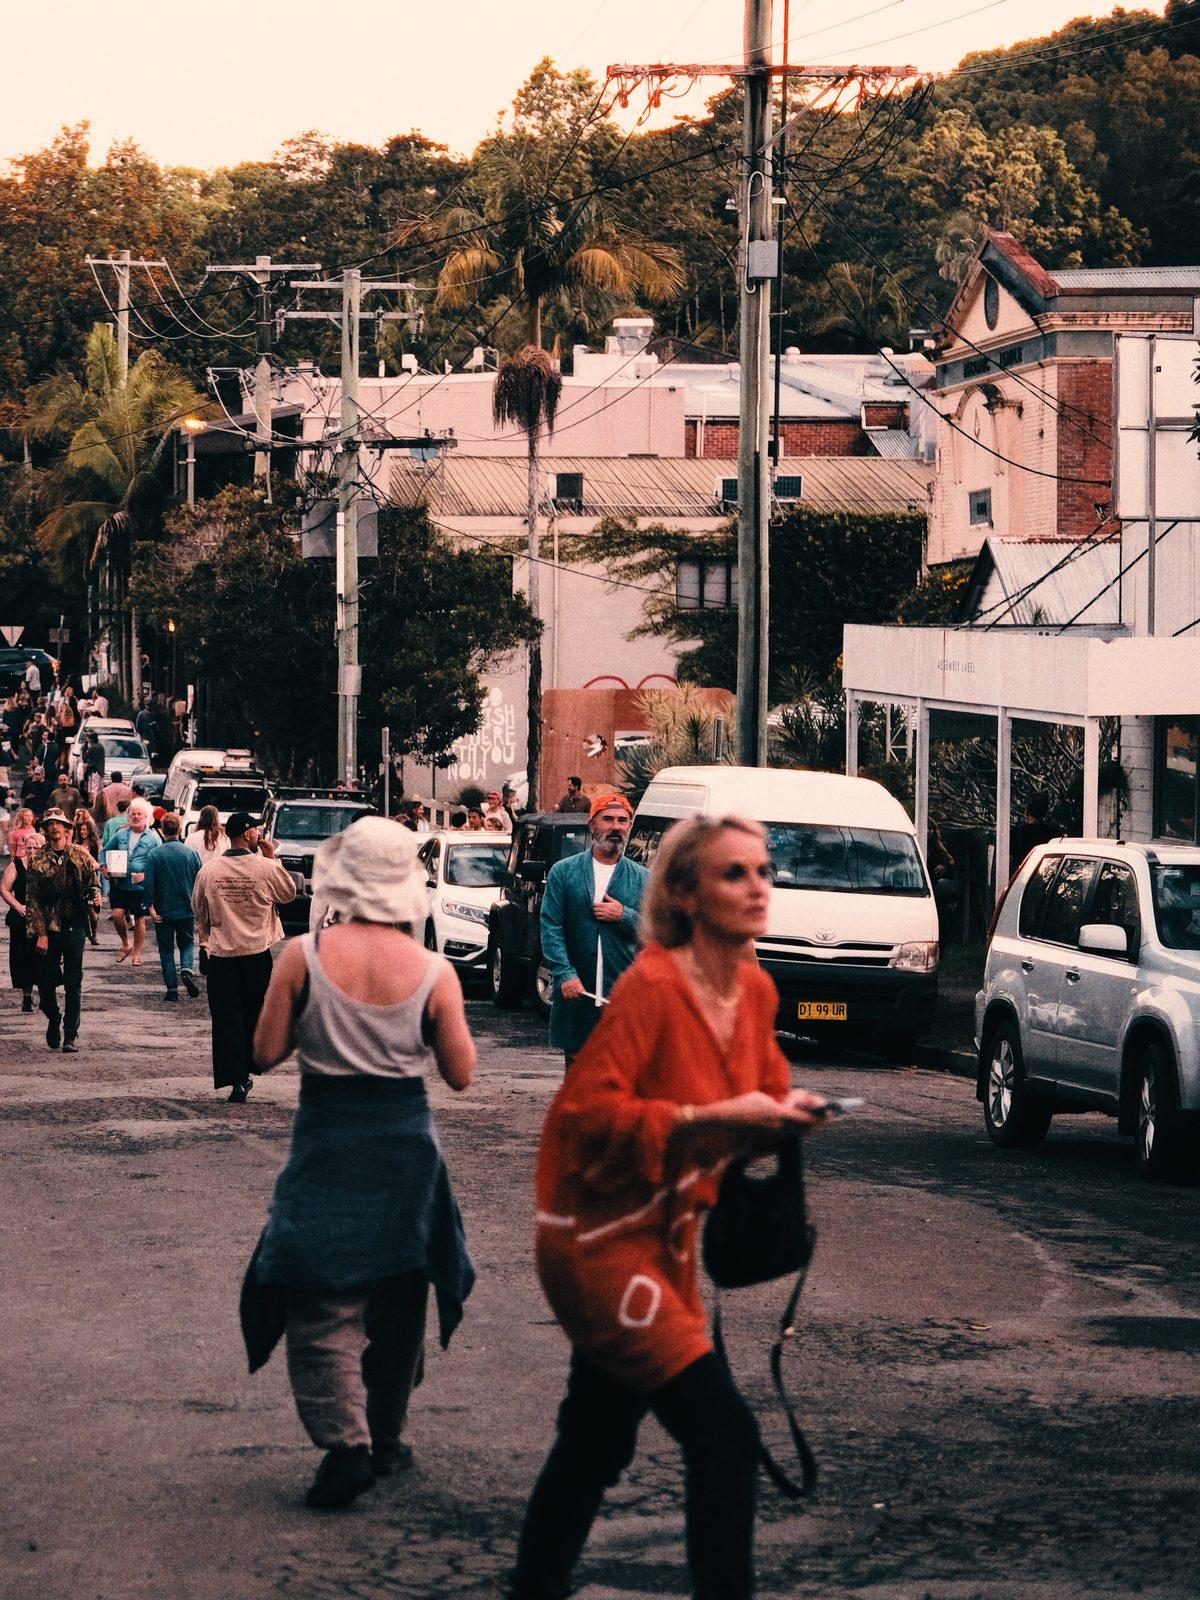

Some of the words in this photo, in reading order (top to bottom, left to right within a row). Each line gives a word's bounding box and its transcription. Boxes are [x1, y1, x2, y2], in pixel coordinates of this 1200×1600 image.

[961, 662, 976, 673] LABEL
[448, 745, 486, 780] NOW
[480, 744, 515, 765] YOU
[816, 1004, 829, 1016] 99
[832, 1003, 846, 1016] UR
